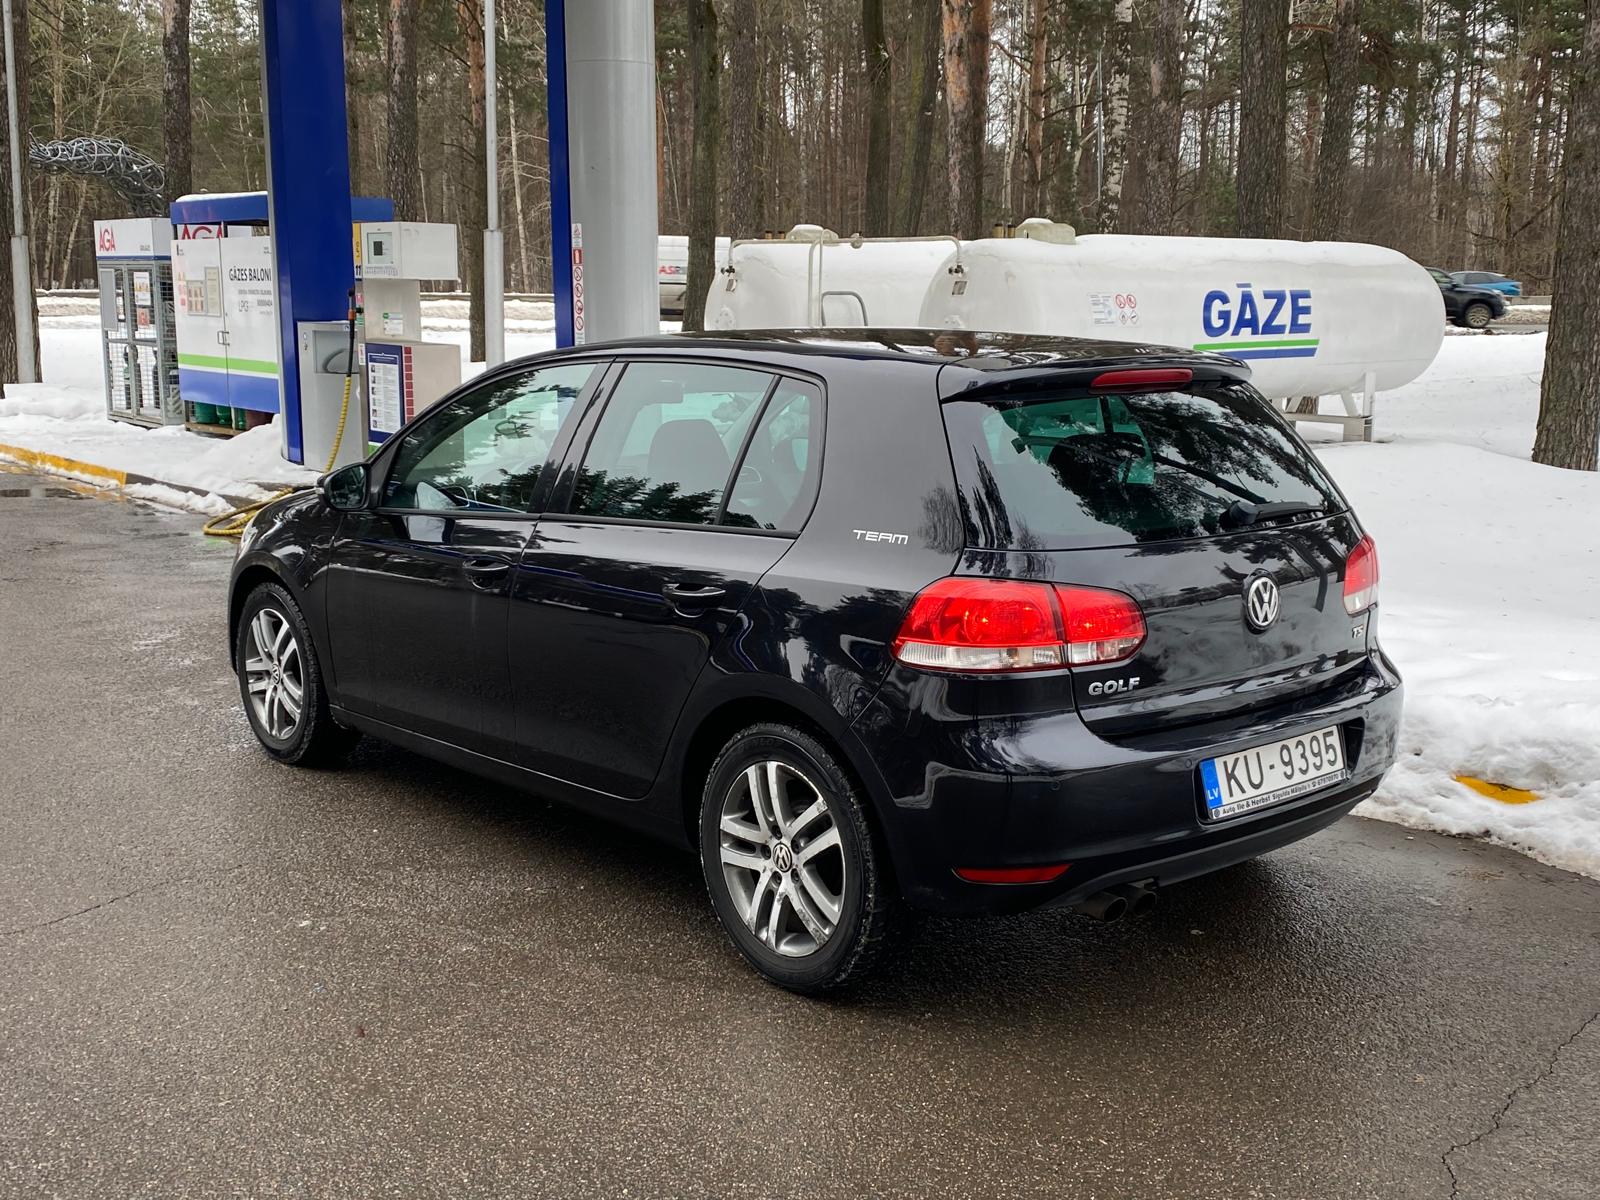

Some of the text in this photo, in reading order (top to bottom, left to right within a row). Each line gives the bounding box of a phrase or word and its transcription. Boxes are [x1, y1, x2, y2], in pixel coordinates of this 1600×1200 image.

[99, 226, 116, 252] AGA
[229, 265, 272, 281] GĀZES BALONI
[1202, 282, 1312, 338] GĀZE
[853, 529, 909, 545] TEAM
[1088, 677, 1140, 696] GOLF
[1223, 731, 1338, 798] KU-9395
[1207, 788, 1219, 800] LV
[1251, 796, 1271, 806] Herbst
